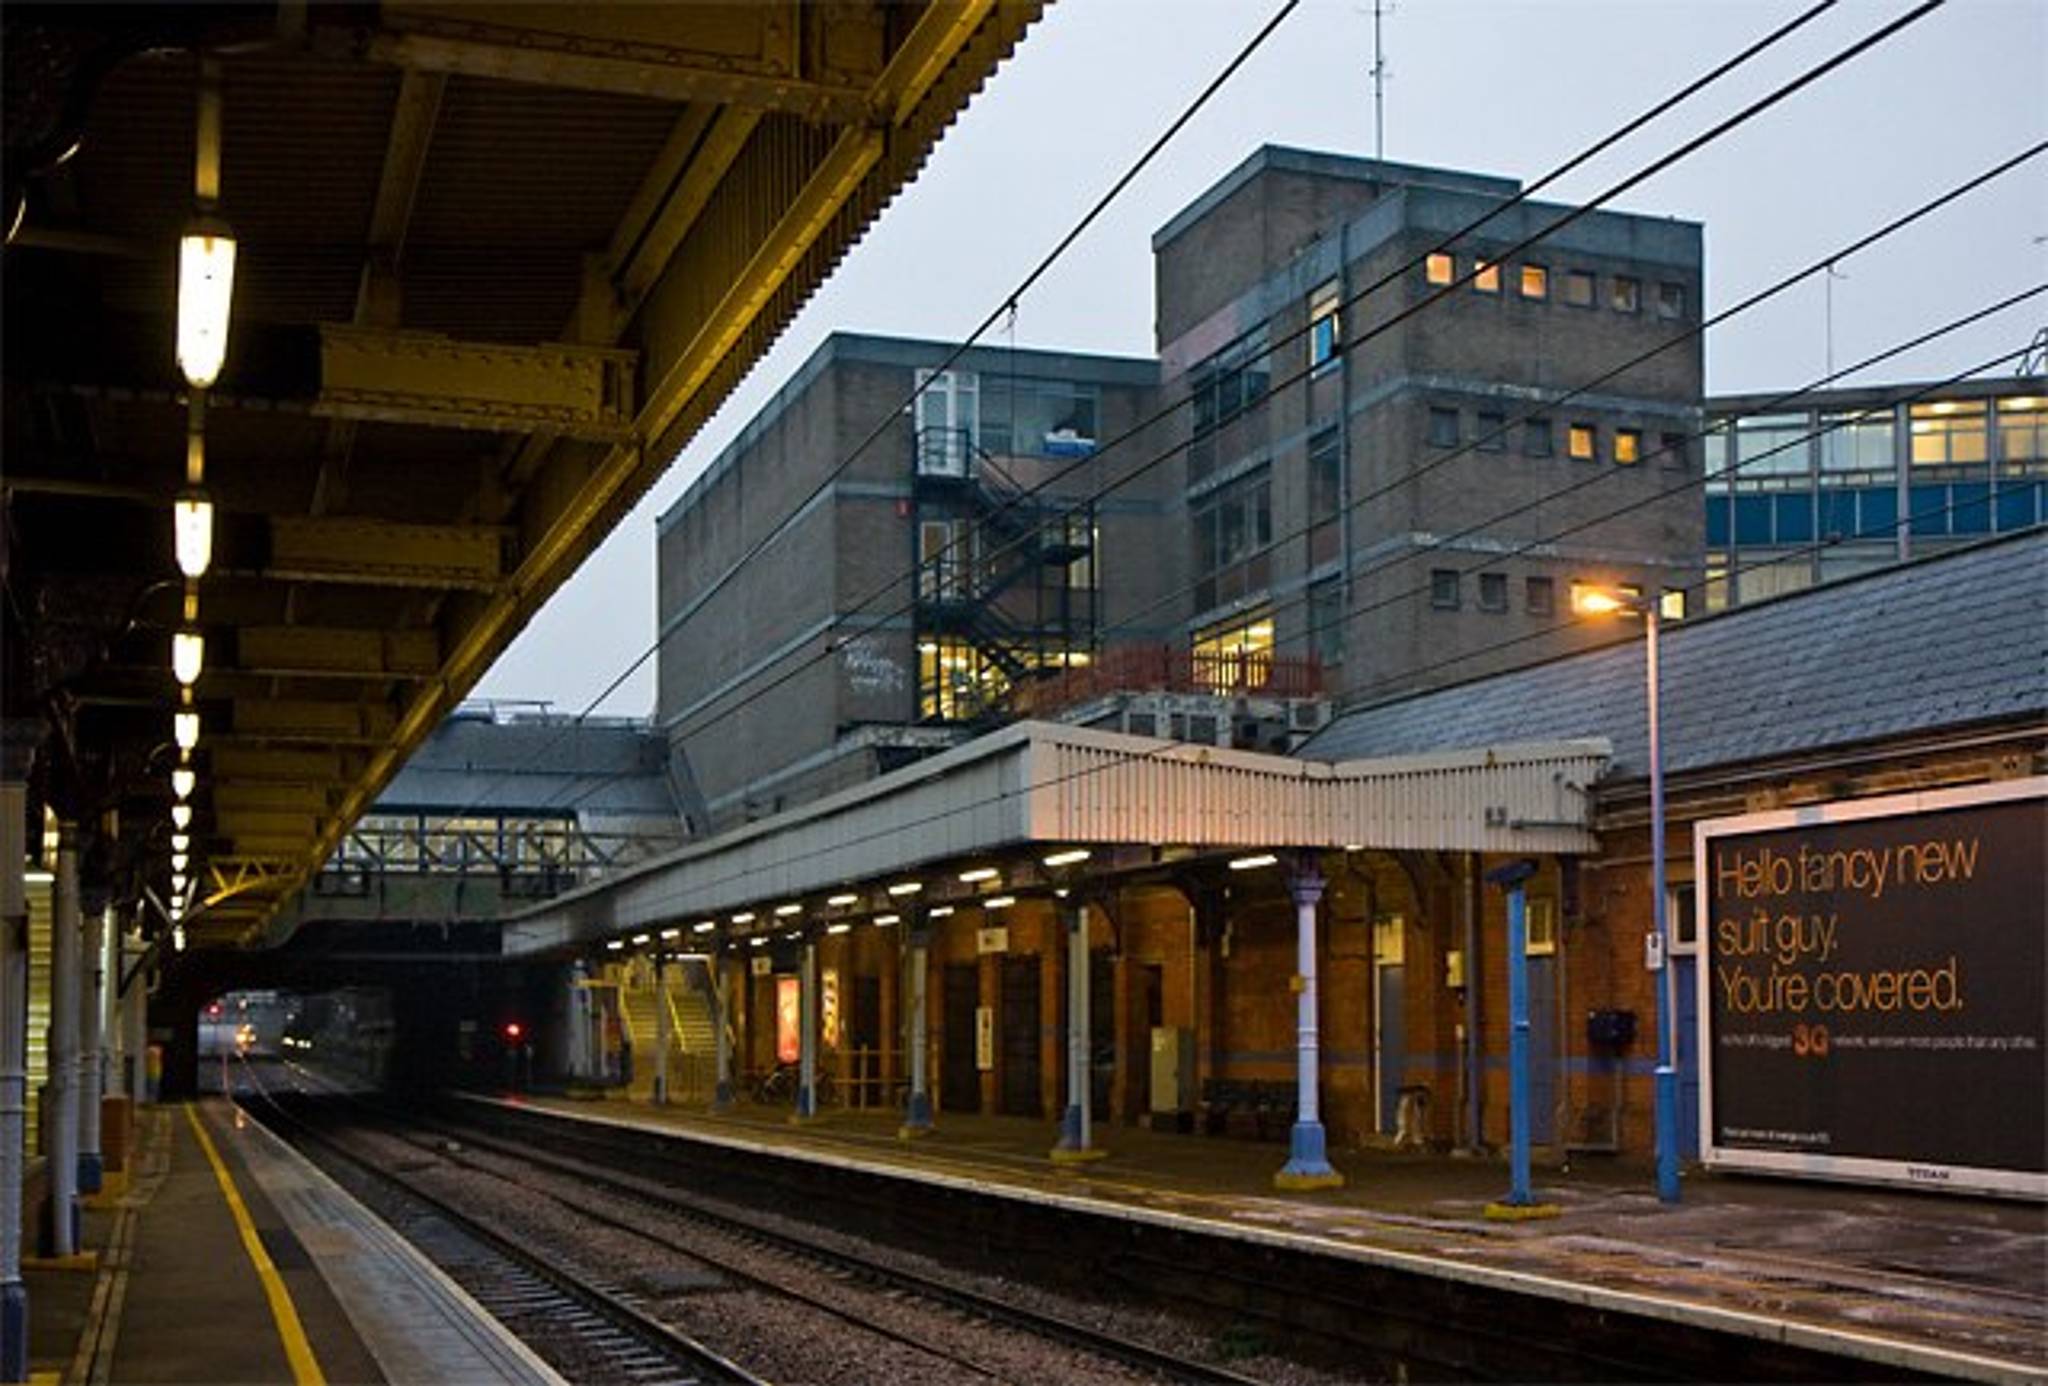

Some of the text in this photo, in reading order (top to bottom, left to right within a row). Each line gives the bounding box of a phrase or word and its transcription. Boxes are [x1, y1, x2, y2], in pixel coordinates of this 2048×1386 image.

[1717, 838, 1979, 898] Hello fancy new
[1717, 907, 1838, 965] suit guy.
[1717, 956, 1964, 1012] You're covered.
